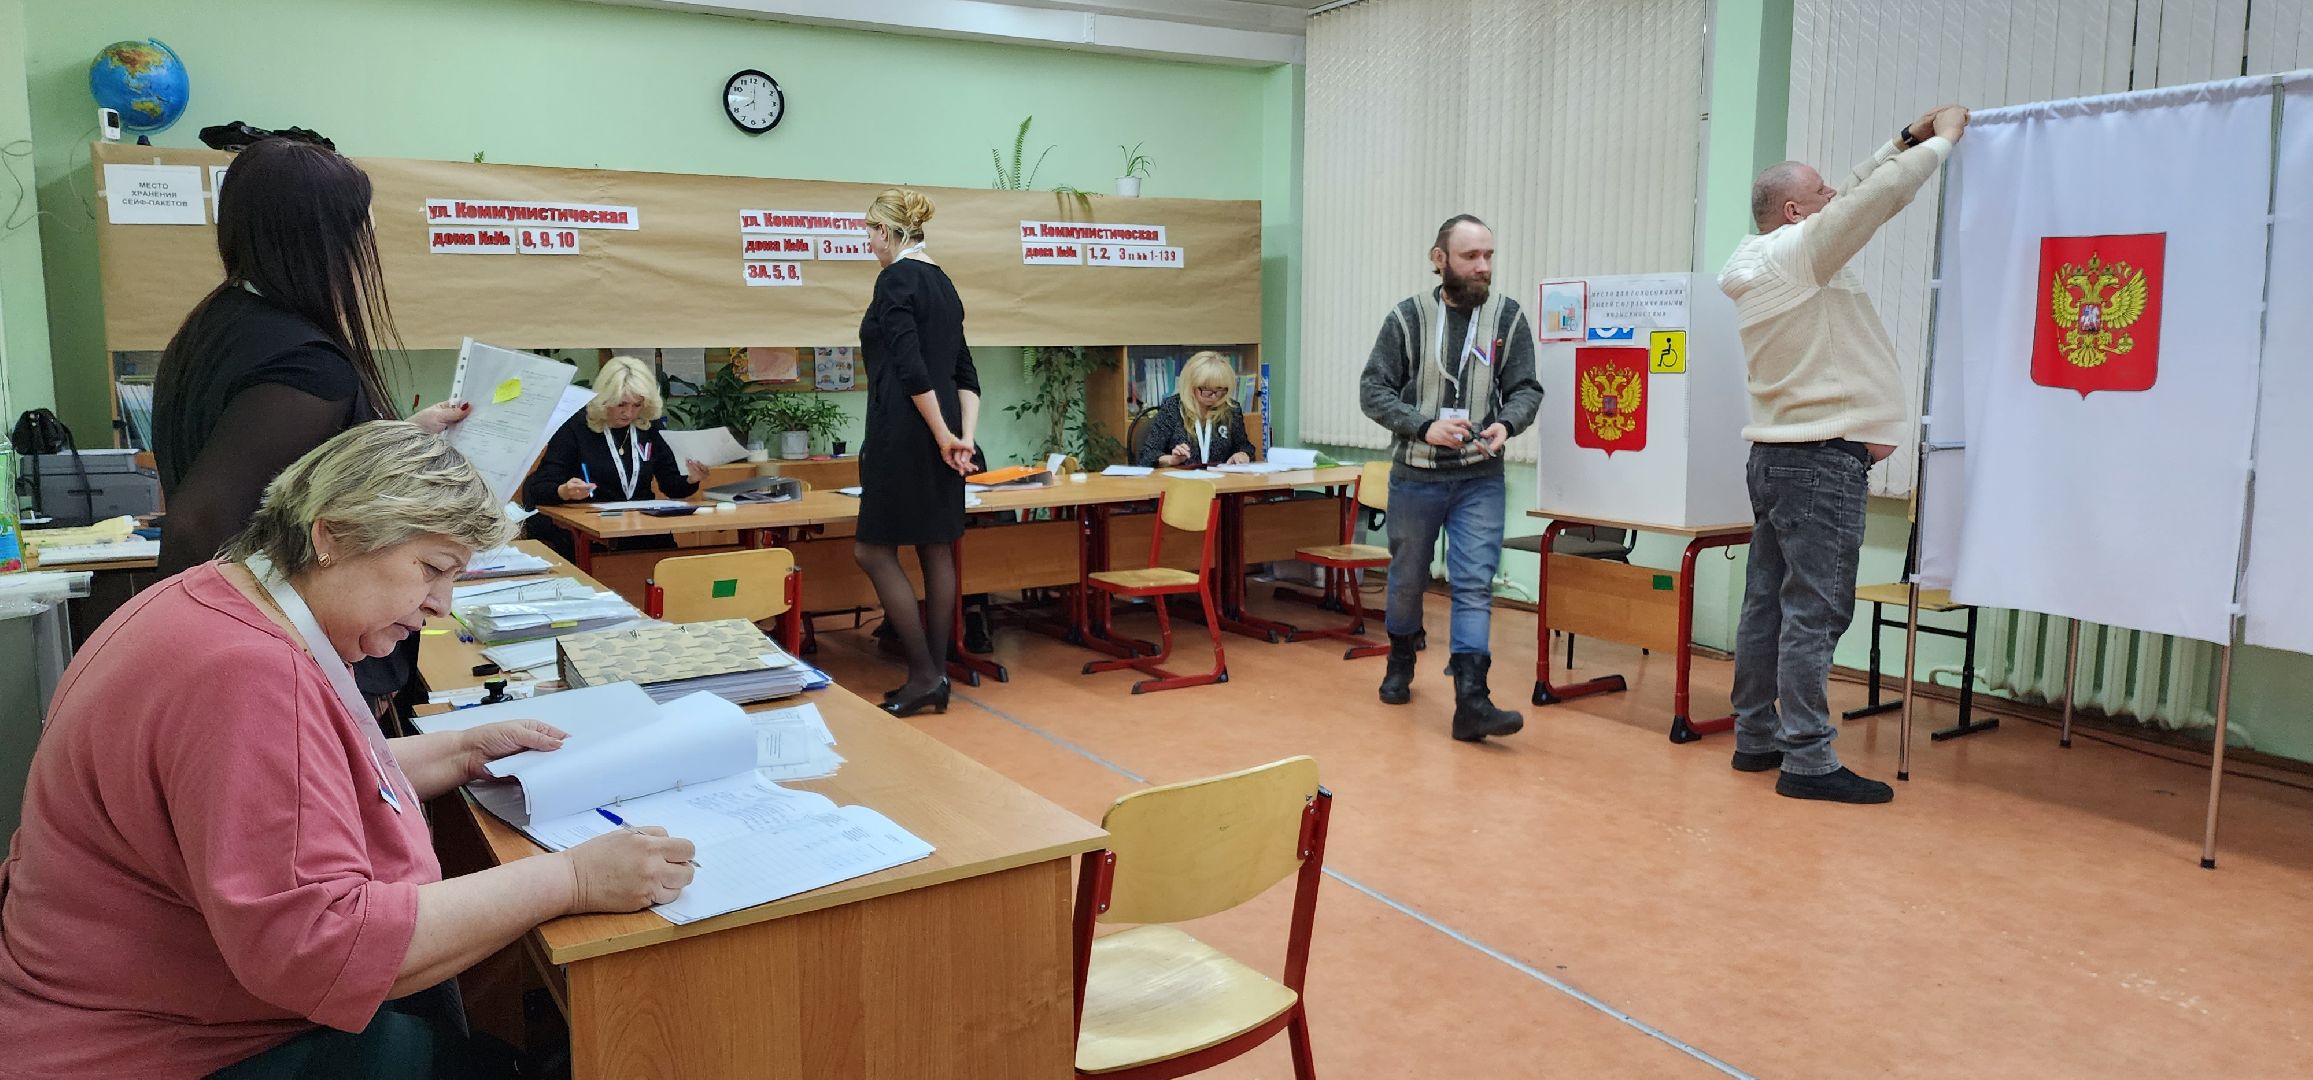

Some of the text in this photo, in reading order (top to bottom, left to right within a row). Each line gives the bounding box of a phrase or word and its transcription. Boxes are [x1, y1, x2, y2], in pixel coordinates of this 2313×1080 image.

[138, 182, 169, 190] МЕСТО
[131, 190, 177, 198] ХРАНЕНИЯ
[122, 198, 188, 207] СЕЙФ-ПАКЕТОВ
[428, 202, 629, 224] ул. Коммунистическая
[741, 212, 867, 230] ул. Коммунистич
[432, 231, 476, 247] дома
[521, 230, 537, 249] 8,
[540, 231, 554, 249] 9,
[556, 231, 575, 249] 10
[1022, 223, 1159, 242] ул. Коммунистическая
[745, 240, 781, 253] дома
[823, 240, 832, 254] 3
[1025, 246, 1054, 259] дома
[772, 264, 785, 280] 5,
